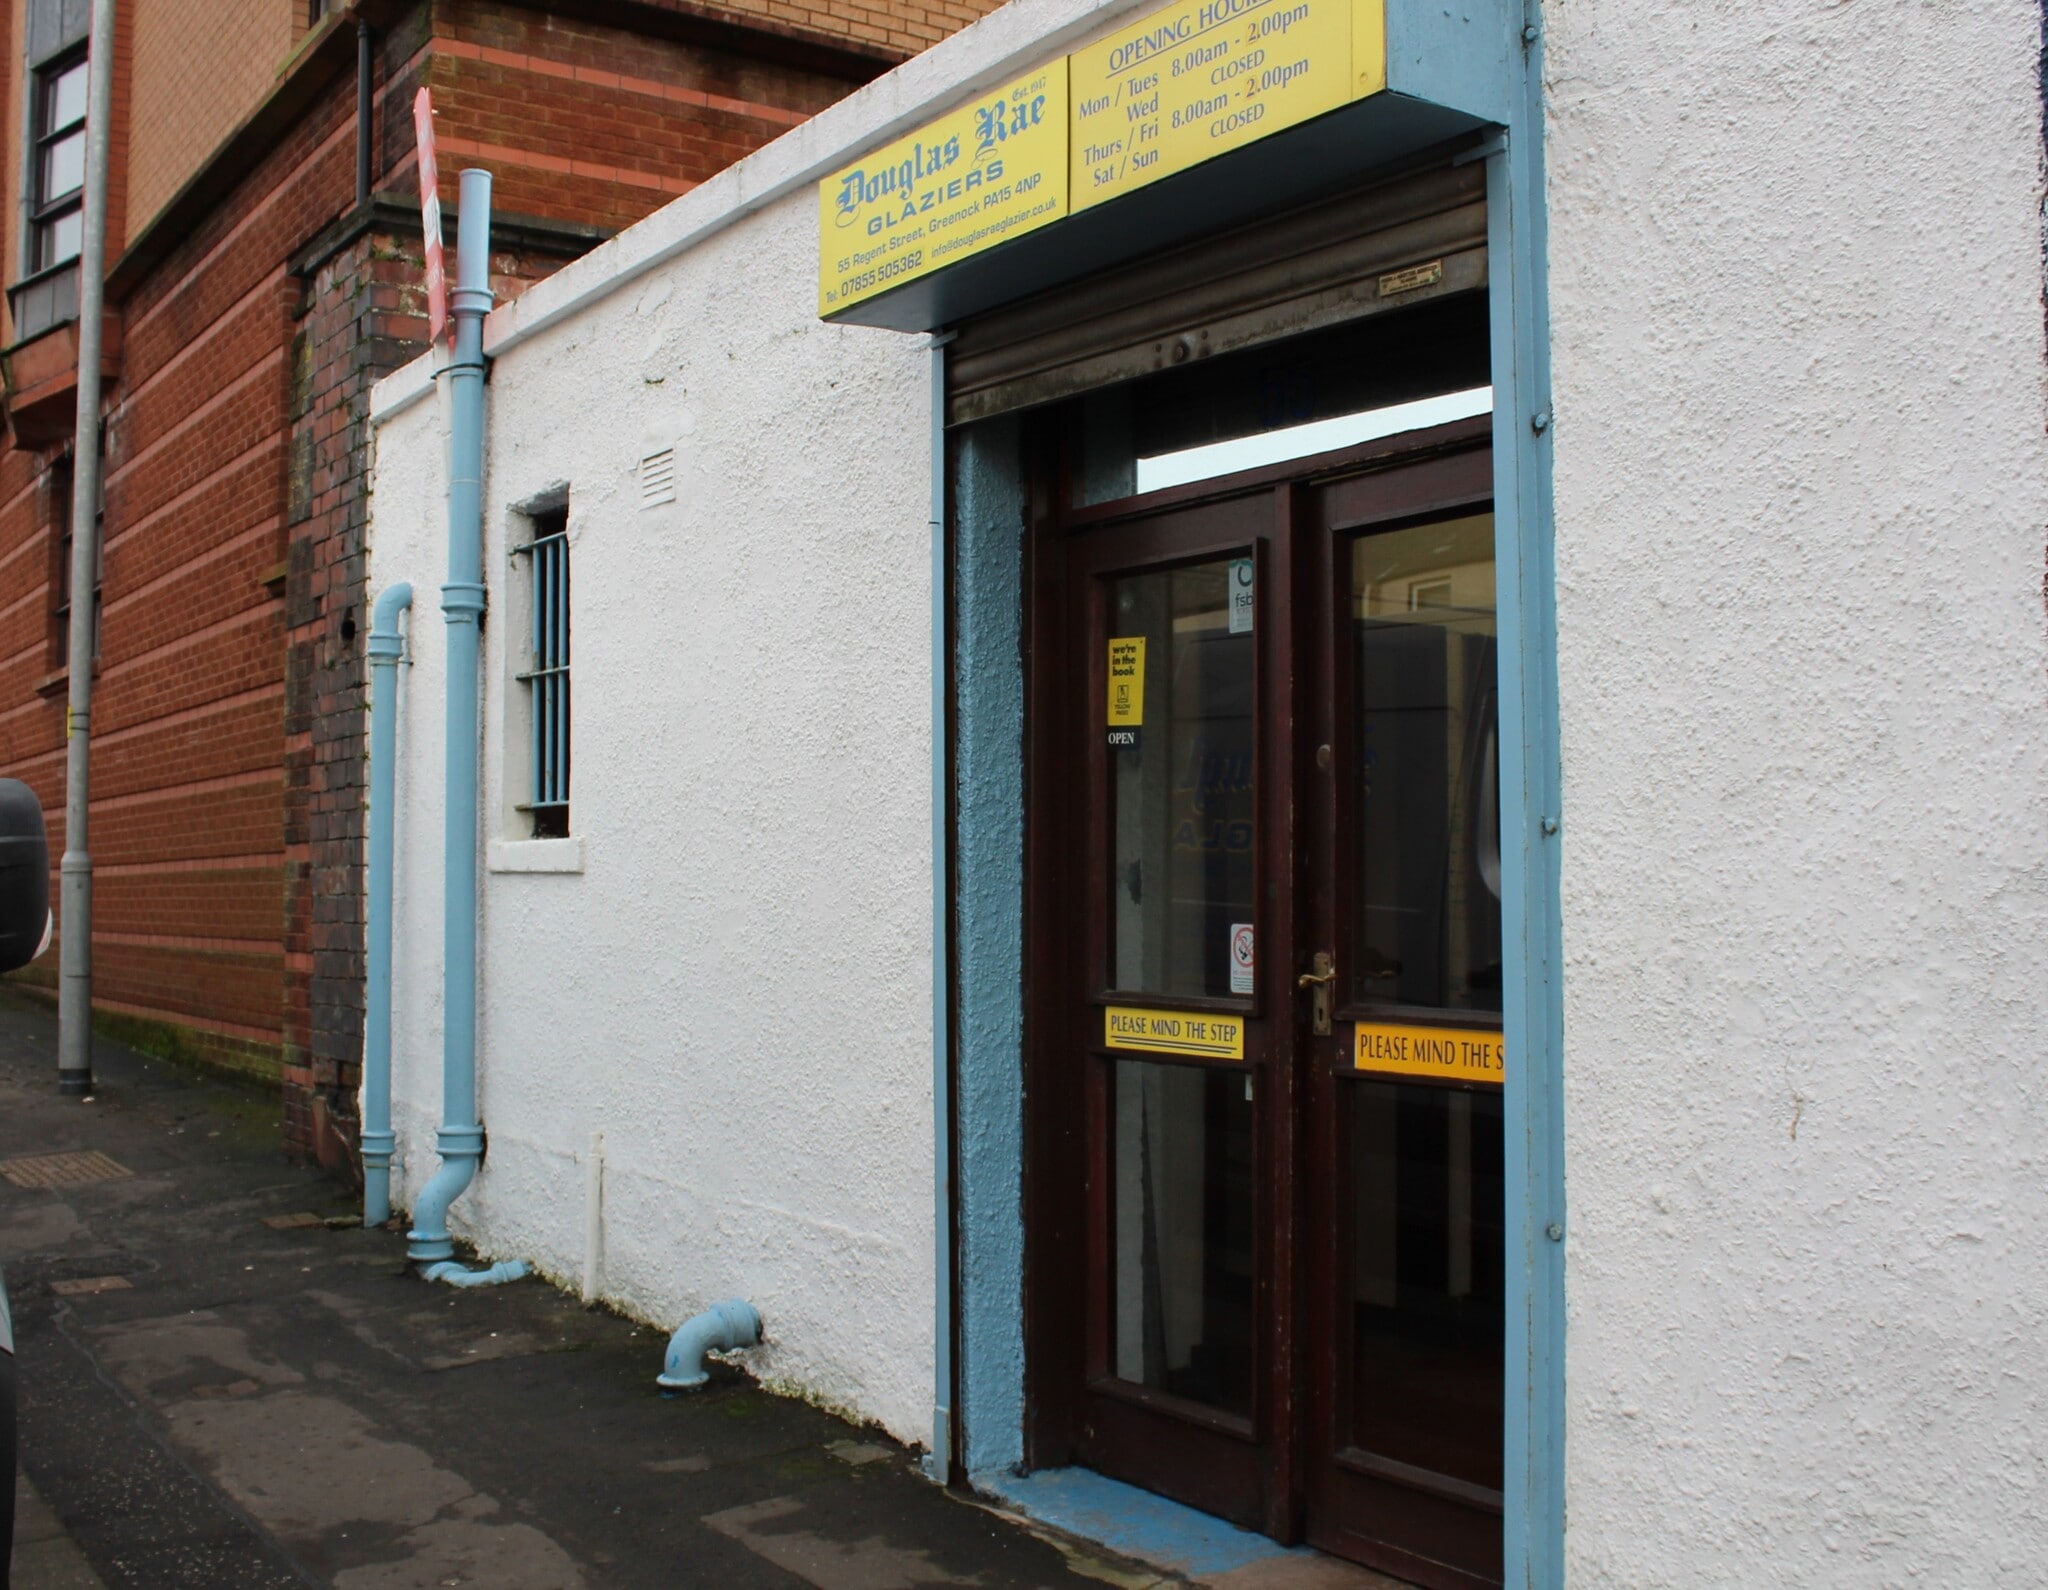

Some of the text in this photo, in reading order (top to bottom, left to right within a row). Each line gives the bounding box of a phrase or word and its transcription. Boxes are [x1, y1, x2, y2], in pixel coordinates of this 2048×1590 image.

[1079, 95, 1110, 120] Mon
[1114, 82, 1122, 108] /
[1128, 73, 1159, 98] Tues
[1172, 40, 1228, 78] 8.00am
[1247, 3, 1309, 42] 2.00pm
[1109, 15, 1191, 71] OPENING
[1084, 140, 1122, 167] Thurs
[1127, 127, 1134, 151] /
[1140, 118, 1159, 144] Fri
[1172, 94, 1228, 130] 8.00am
[1246, 58, 1309, 98] 2.00pm
[1127, 49, 1265, 123] Wed CLOSED
[835, 95, 1046, 228] Douglas Rae
[1093, 103, 1265, 188] Sat / Sun CLOSED
[838, 173, 1042, 273] 55 Regent Street, Greenock PA15 4NP
[867, 160, 1004, 236] GLAZIERS
[841, 271, 875, 297] 07855
[878, 251, 922, 281] 505362
[931, 197, 1057, 258] info@douglasraeglazier.co.uk
[1235, 592, 1253, 608] fsb
[1112, 643, 1137, 654] we're
[1112, 654, 1136, 665] in the
[1112, 665, 1135, 676] book
[1108, 732, 1135, 744] OPEN
[1111, 1015, 1237, 1042] PLEASE MIND THE STEP
[1360, 1034, 1408, 1061] PLEASE
[1413, 1038, 1456, 1064] MIND
[1461, 1042, 1490, 1069] THE
